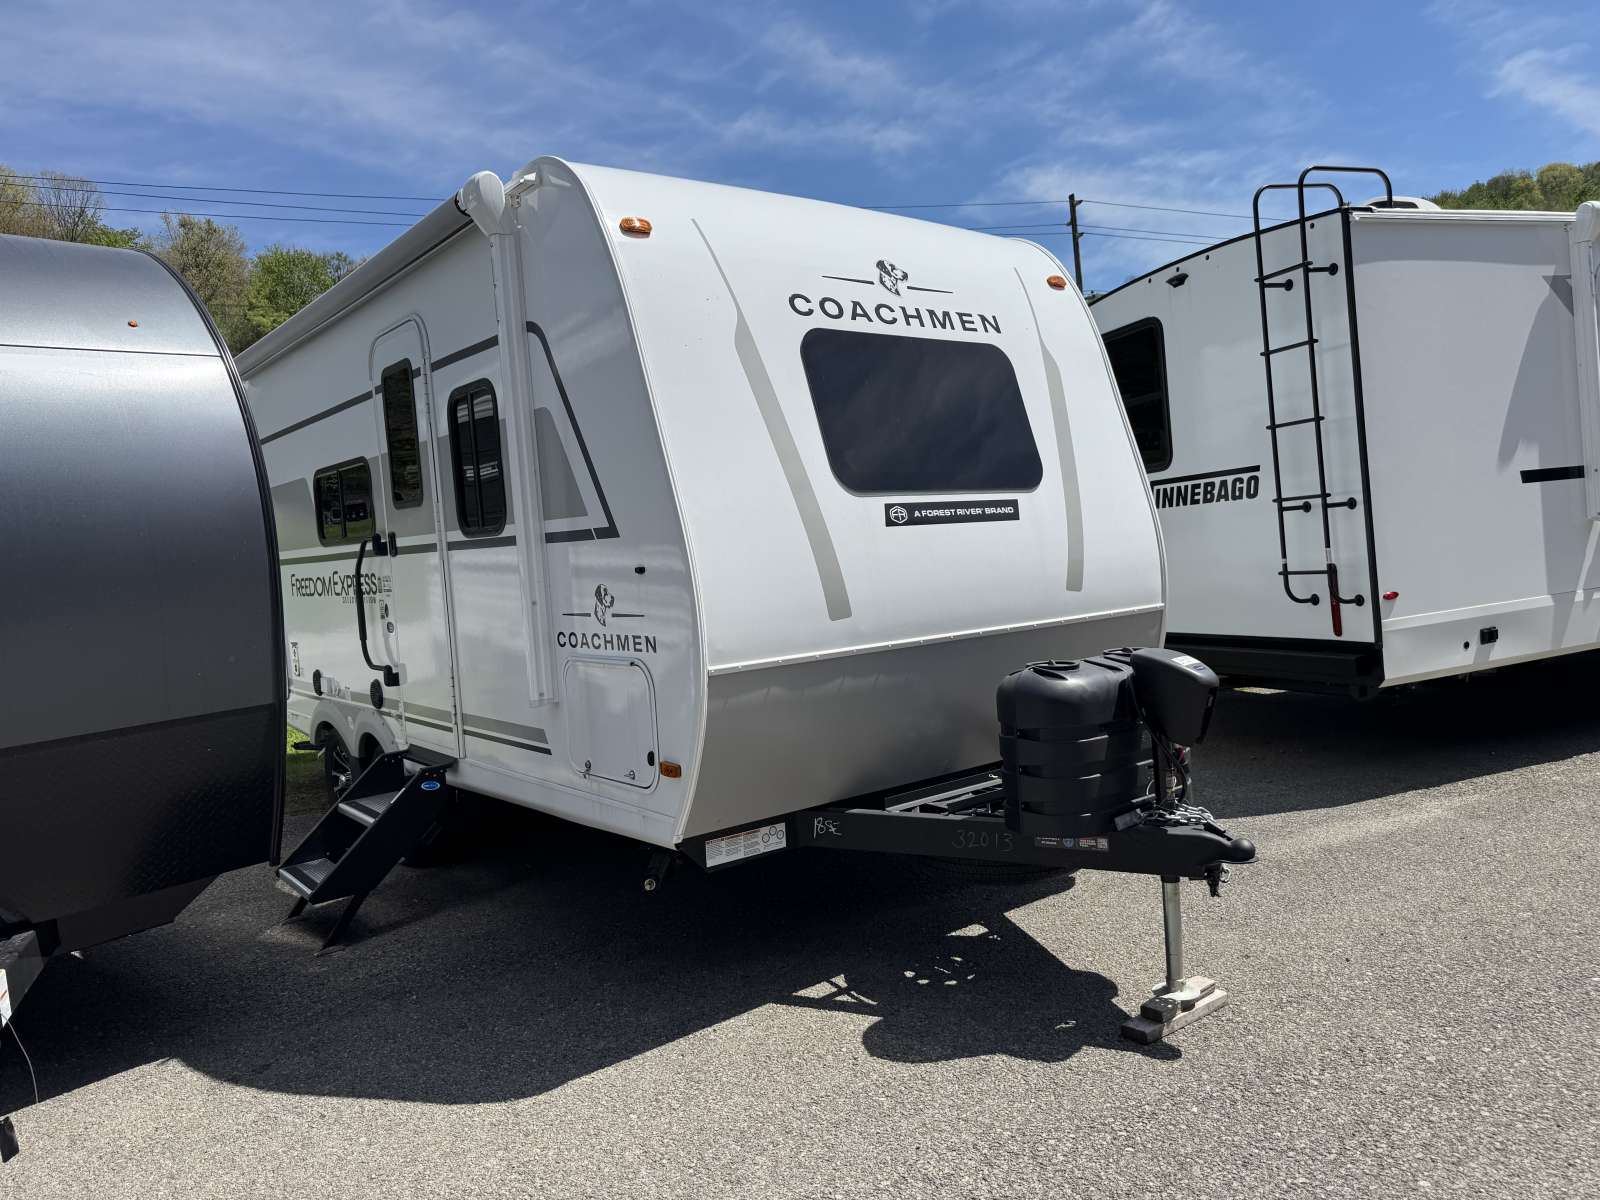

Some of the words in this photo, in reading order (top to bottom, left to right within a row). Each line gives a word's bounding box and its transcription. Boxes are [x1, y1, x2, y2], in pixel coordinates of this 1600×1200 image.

[788, 293, 1002, 334] COACHMEN
[1150, 474, 1260, 509] INNEBAGO
[914, 510, 921, 518] A
[922, 508, 957, 517] FOREST
[985, 506, 1014, 514] BRAND
[557, 631, 657, 653] COACHMEN
